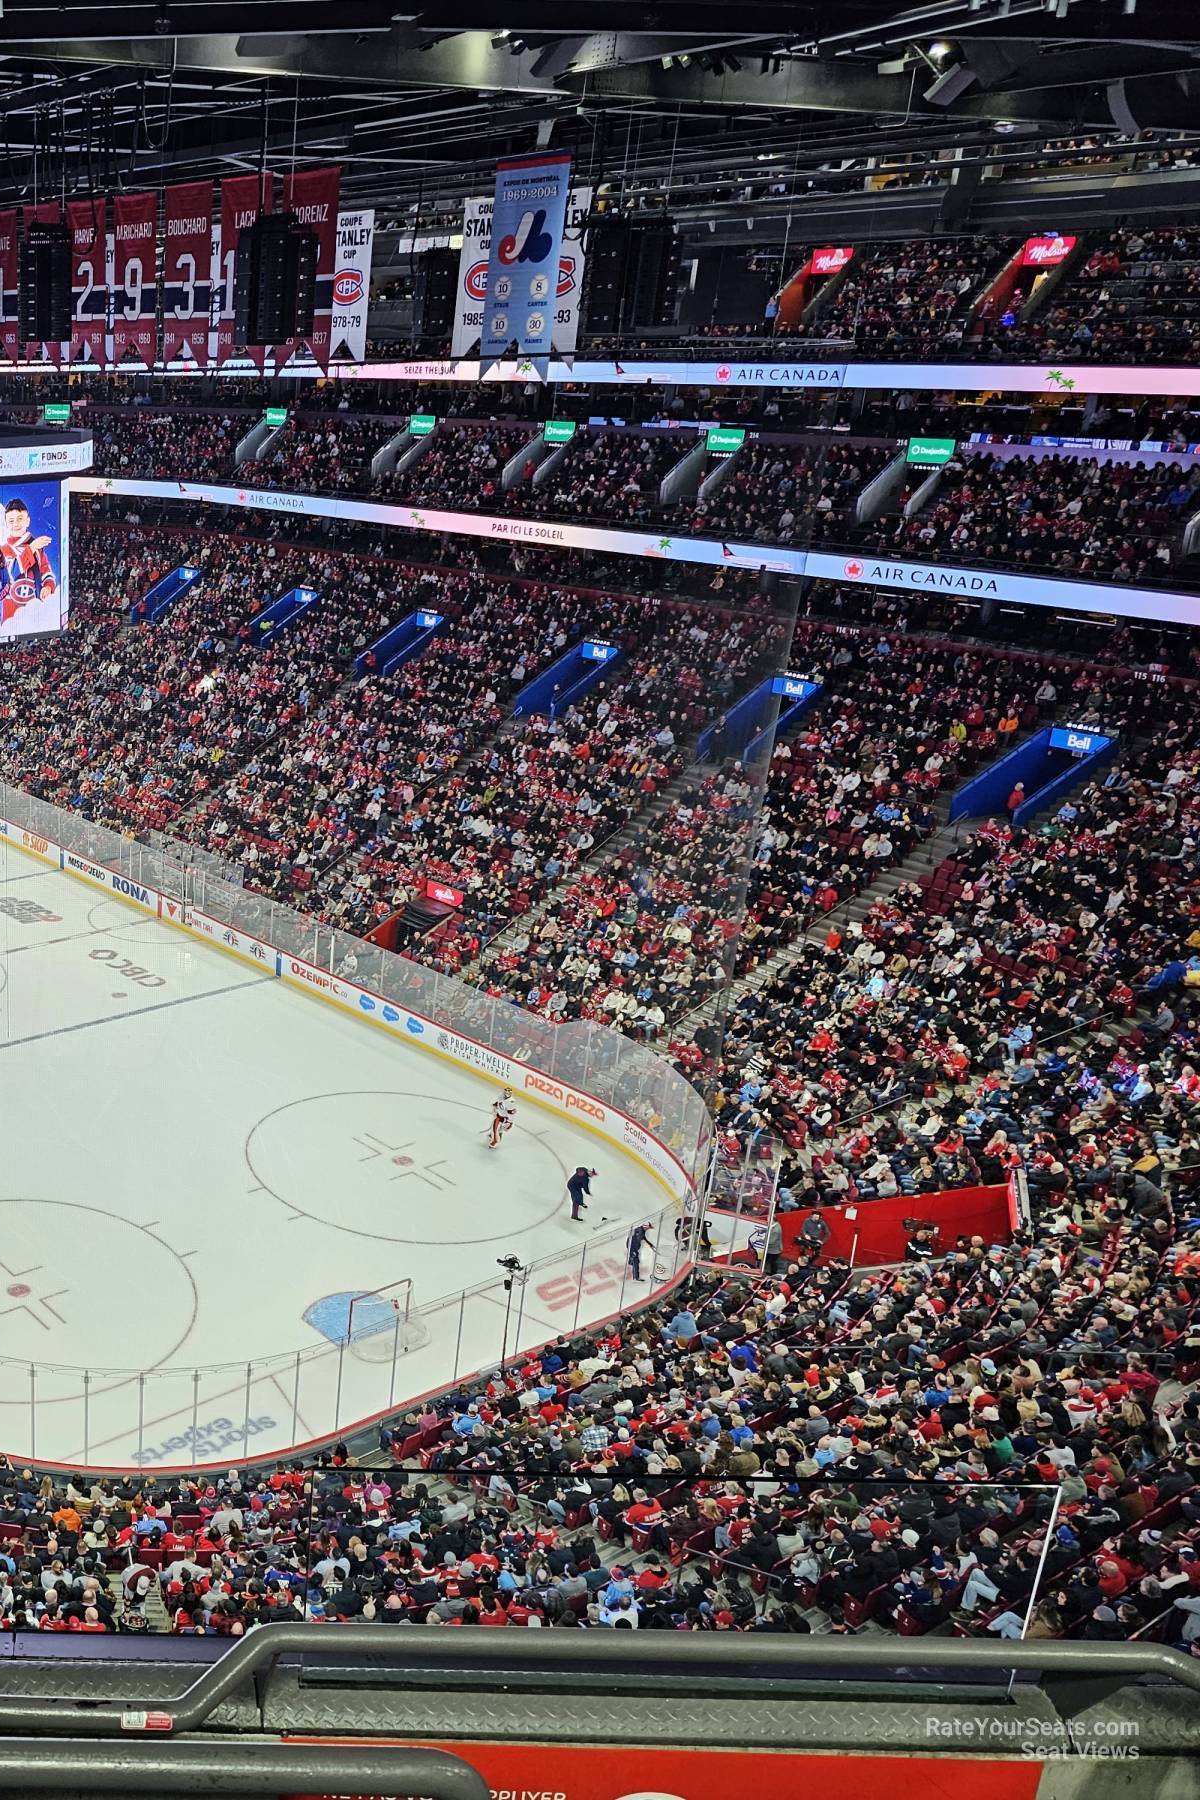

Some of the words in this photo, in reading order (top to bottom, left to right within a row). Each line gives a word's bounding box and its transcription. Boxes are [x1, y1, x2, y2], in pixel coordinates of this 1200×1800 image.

[503, 185, 558, 200] 1969-2004
[168, 217, 207, 236] BOUCHARD
[340, 216, 363, 227] COUPE
[466, 218, 492, 238] STAN
[336, 228, 372, 248] TANLEY
[343, 249, 357, 260] CUP
[1028, 244, 1072, 260] Molson
[815, 254, 848, 270] Molson
[76, 261, 94, 321] 2
[123, 257, 143, 321] 9
[174, 253, 196, 320] 3
[498, 283, 508, 294] 10
[535, 281, 543, 292] 8
[494, 319, 504, 330] 10
[529, 319, 541, 330] 30
[138, 332, 151, 344] 1960
[191, 332, 205, 344] 1956
[312, 332, 327, 345] 1937
[405, 366, 422, 374] SEIZE
[425, 366, 439, 374] THE
[738, 368, 767, 380] AIR
[770, 368, 841, 382] CANADA
[42, 451, 68, 461] FONDS
[921, 446, 950, 455] Desjardins
[250, 494, 265, 504] AIR
[266, 496, 304, 508] CANADA
[491, 523, 508, 533] PAR
[510, 525, 522, 535] ICI
[523, 526, 534, 536] LE
[534, 528, 564, 540] SOLEIL
[871, 566, 904, 582] AIR
[911, 570, 998, 593] CANADA
[592, 647, 607, 659] Bell
[1134, 671, 1148, 681] 115
[1152, 673, 1166, 683] 116
[785, 681, 803, 695] Bell
[1068, 734, 1090, 750] Bell
[30, 835, 49, 855] SKIP
[112, 876, 150, 905] RONA
[450, 1038, 479, 1059] PROPER
[481, 1051, 511, 1073] TWELVE
[475, 1059, 510, 1080] WHISKEY
[524, 1074, 563, 1100] pizza
[565, 1093, 605, 1122] pizza
[624, 1122, 647, 1145] Scotia
[131, 1417, 233, 1465] experts
[190, 1416, 278, 1457] sports
